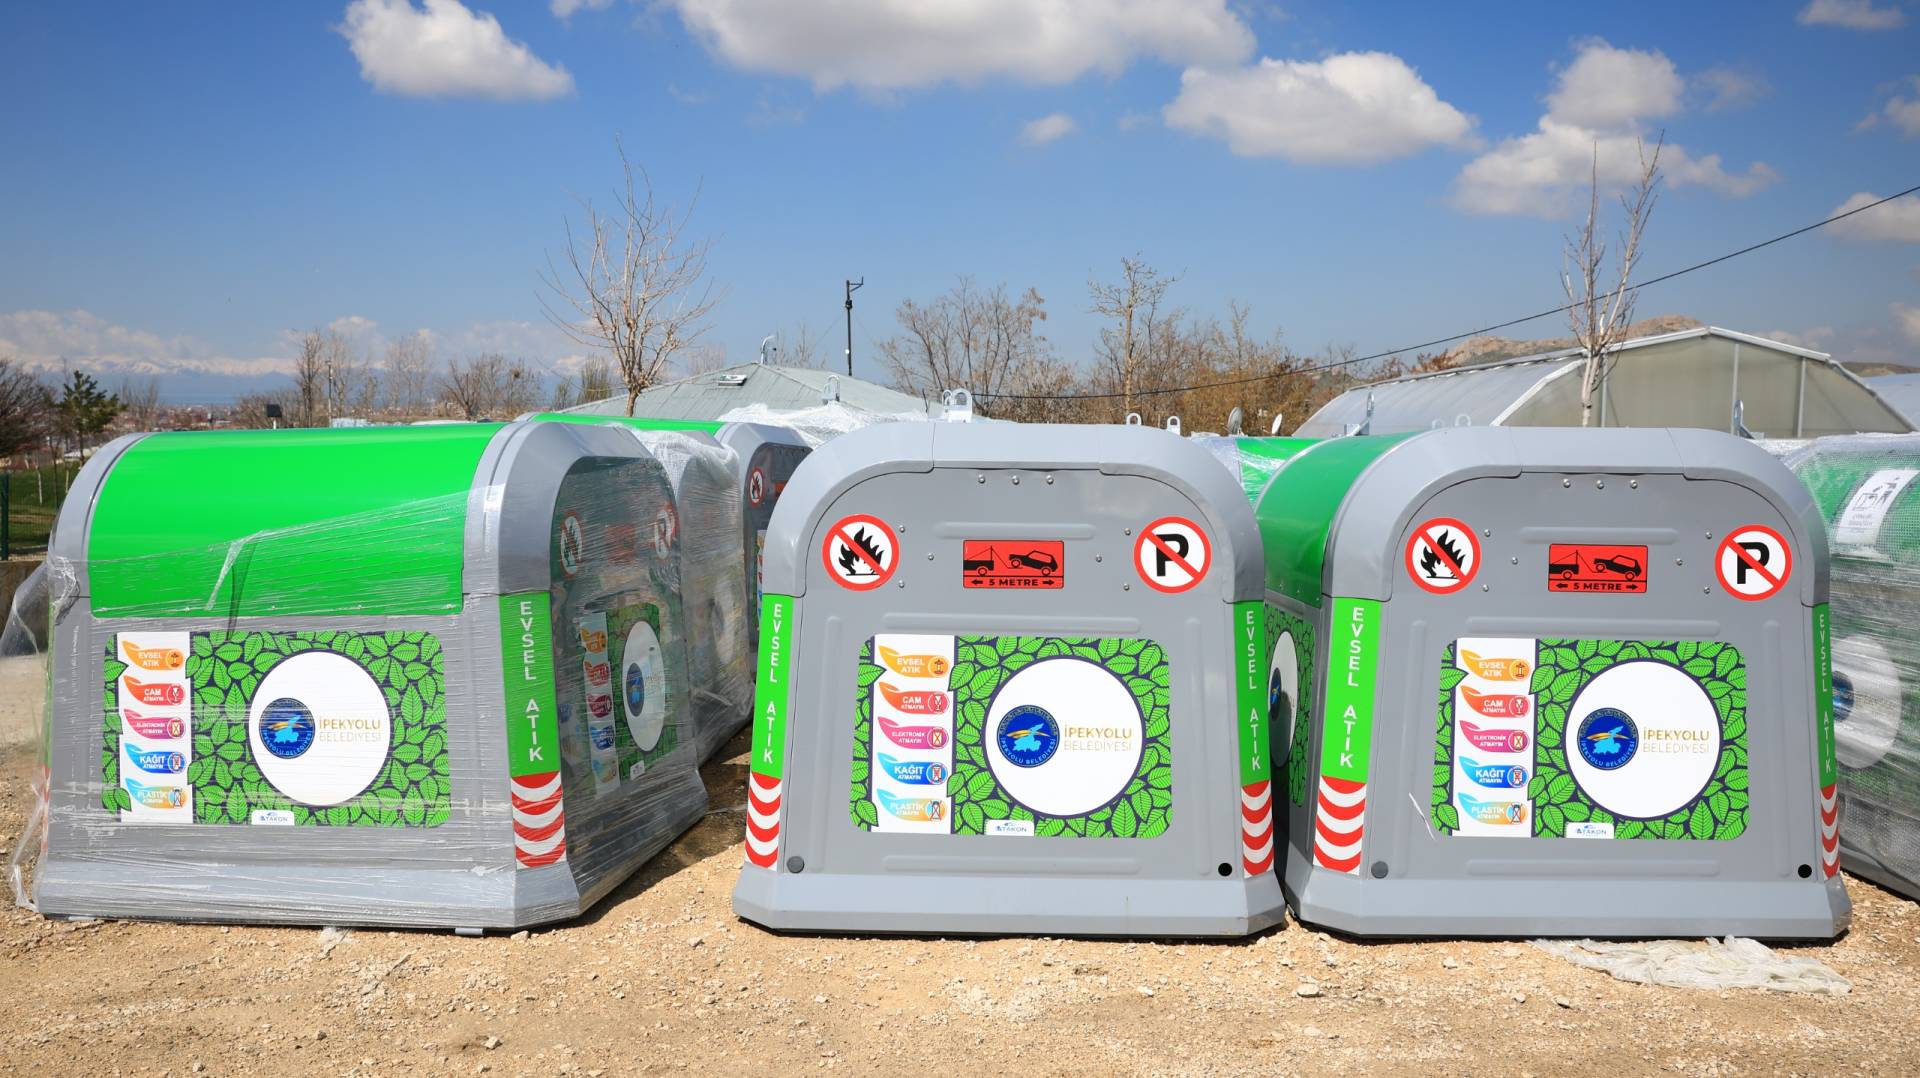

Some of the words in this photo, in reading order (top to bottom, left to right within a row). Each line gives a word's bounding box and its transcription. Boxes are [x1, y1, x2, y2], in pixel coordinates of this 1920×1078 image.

[998, 578, 1038, 586] METRE
[1584, 582, 1622, 591] METRE
[520, 601, 536, 681] EVSEL
[769, 603, 782, 683] EVSEL
[1246, 610, 1256, 690] EVSEL
[1348, 607, 1364, 687] EVSEL
[1819, 614, 1828, 692] EVSEL
[320, 716, 380, 730] İPEKYOLU
[525, 698, 544, 762] ATIK
[764, 700, 776, 764] ATIK
[1064, 724, 1132, 739] İPEKYOLU
[1250, 708, 1260, 770] ATIK
[1340, 704, 1357, 768] ATIK
[1643, 727, 1710, 741] İPEKYOLU
[140, 754, 165, 764] KAĞIT
[1064, 740, 1132, 752] BELEDİYESİ
[1643, 742, 1710, 753] BELEDİYESİ
[1823, 711, 1831, 774] ATIK
[894, 764, 924, 774] KAĞIT
[1476, 768, 1505, 777] KAĞIT
